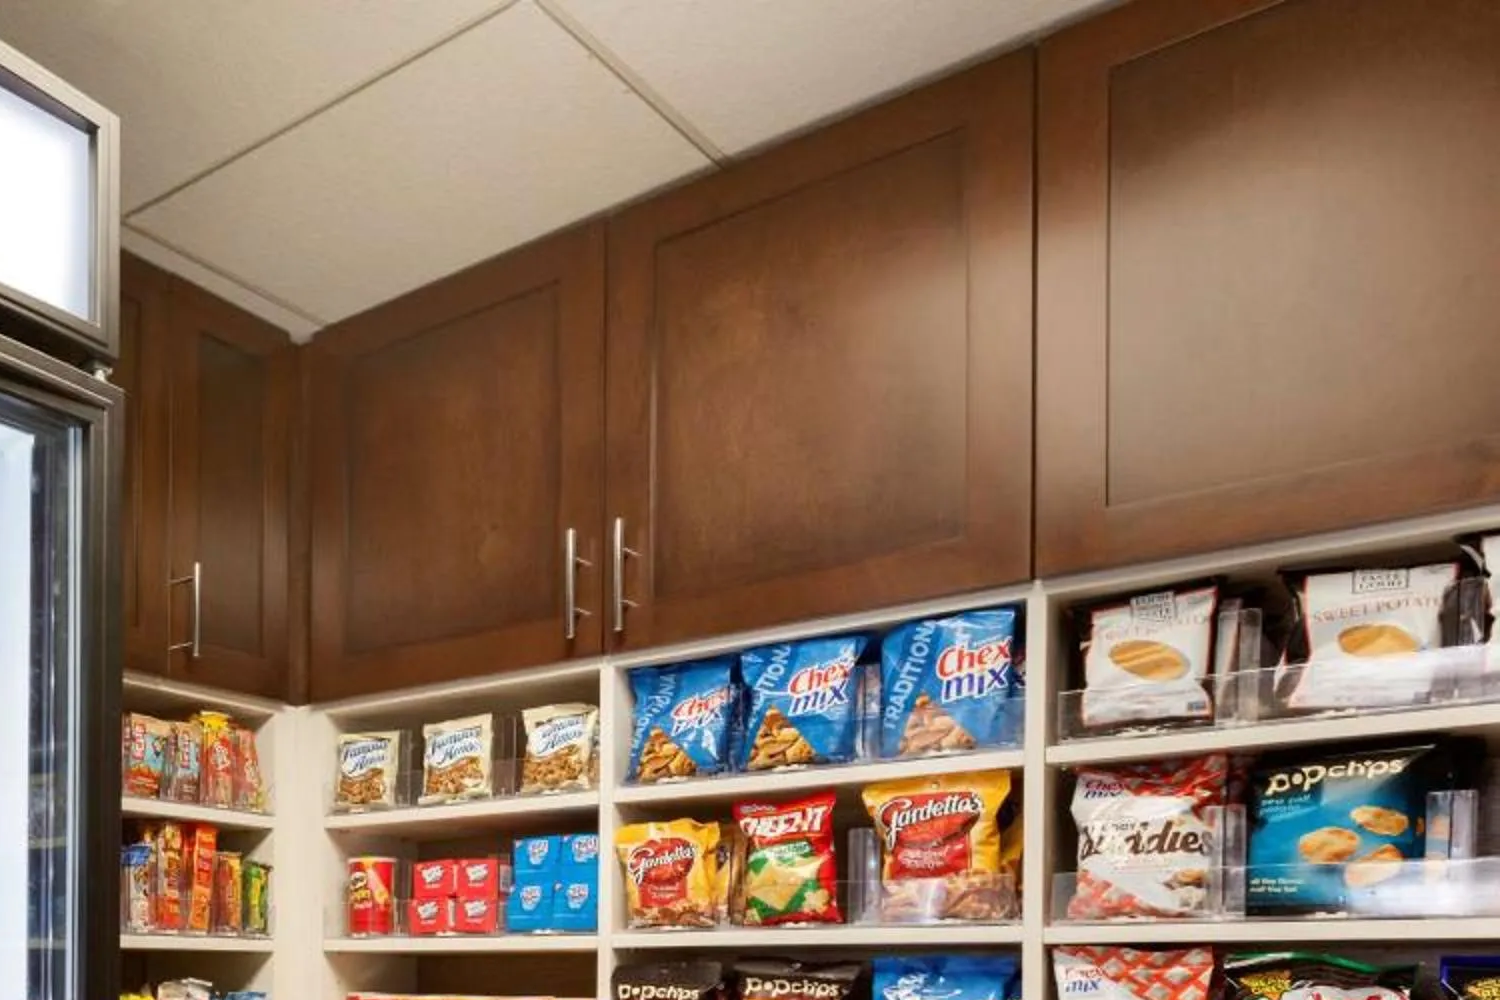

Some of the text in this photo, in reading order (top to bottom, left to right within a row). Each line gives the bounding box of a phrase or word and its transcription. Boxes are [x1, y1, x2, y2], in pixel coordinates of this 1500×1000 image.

[937, 636, 1013, 679] Chex
[788, 659, 852, 697] Chex
[942, 662, 1011, 703] mix
[790, 682, 847, 716] mix
[1264, 758, 1406, 797] popchips
